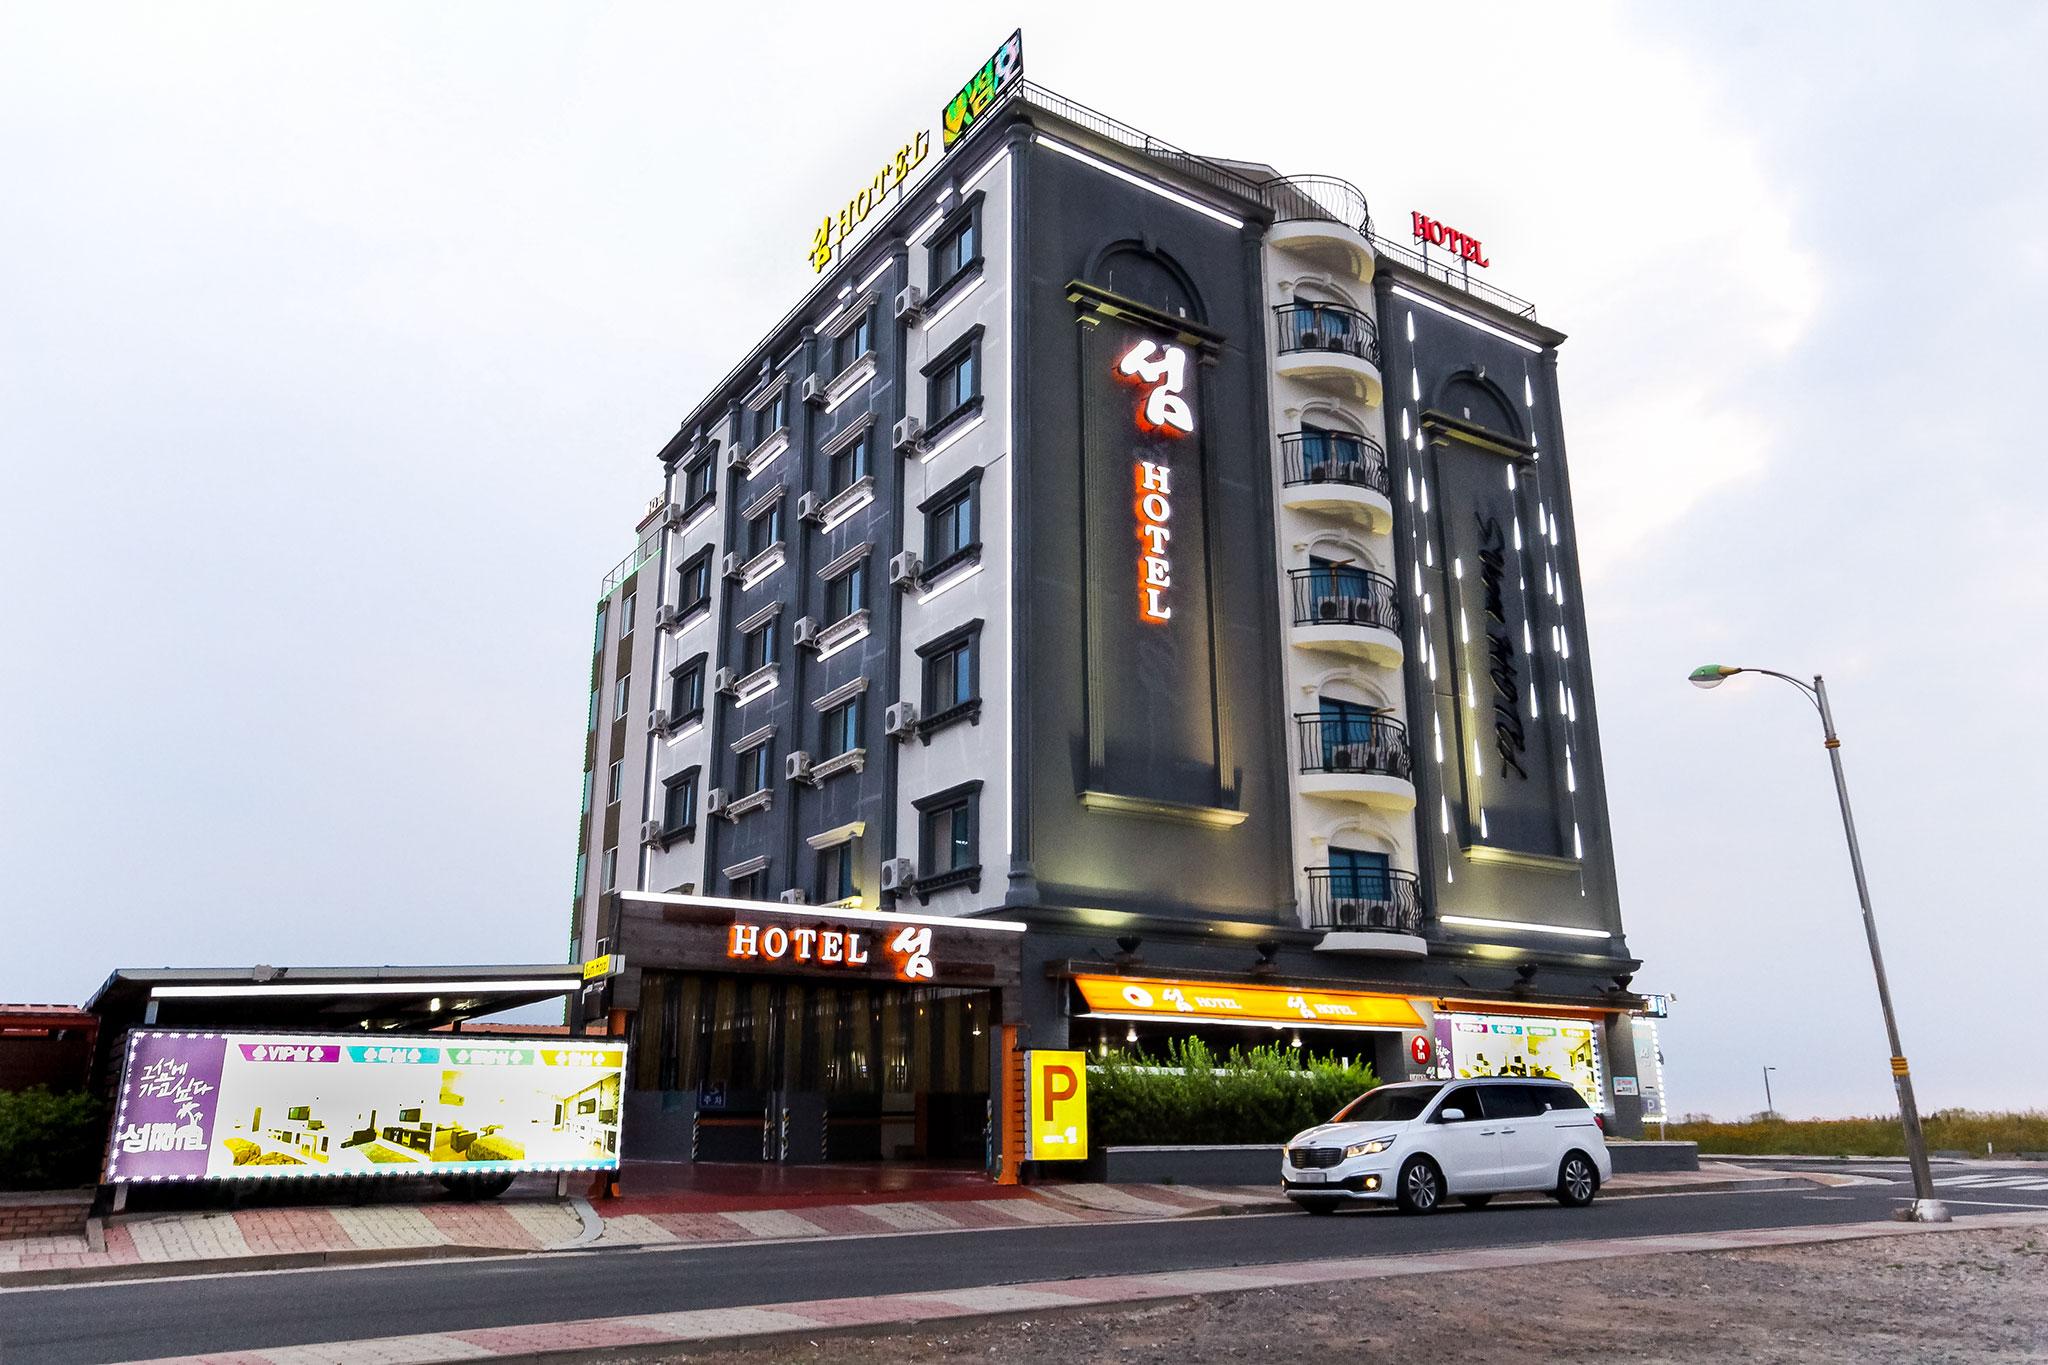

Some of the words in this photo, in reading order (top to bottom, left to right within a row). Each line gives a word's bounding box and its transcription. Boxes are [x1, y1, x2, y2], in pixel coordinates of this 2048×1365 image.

[835, 131, 928, 245] HOTEL
[1411, 210, 1489, 268] HOTEL
[1141, 461, 1171, 620] HOTEL
[732, 924, 868, 964] HOTEL
[1195, 996, 1243, 1009] HOTEL
[1313, 1003, 1358, 1016] HOTEL
[1417, 1049, 1426, 1060] in
[1043, 1065, 1078, 1121] P
